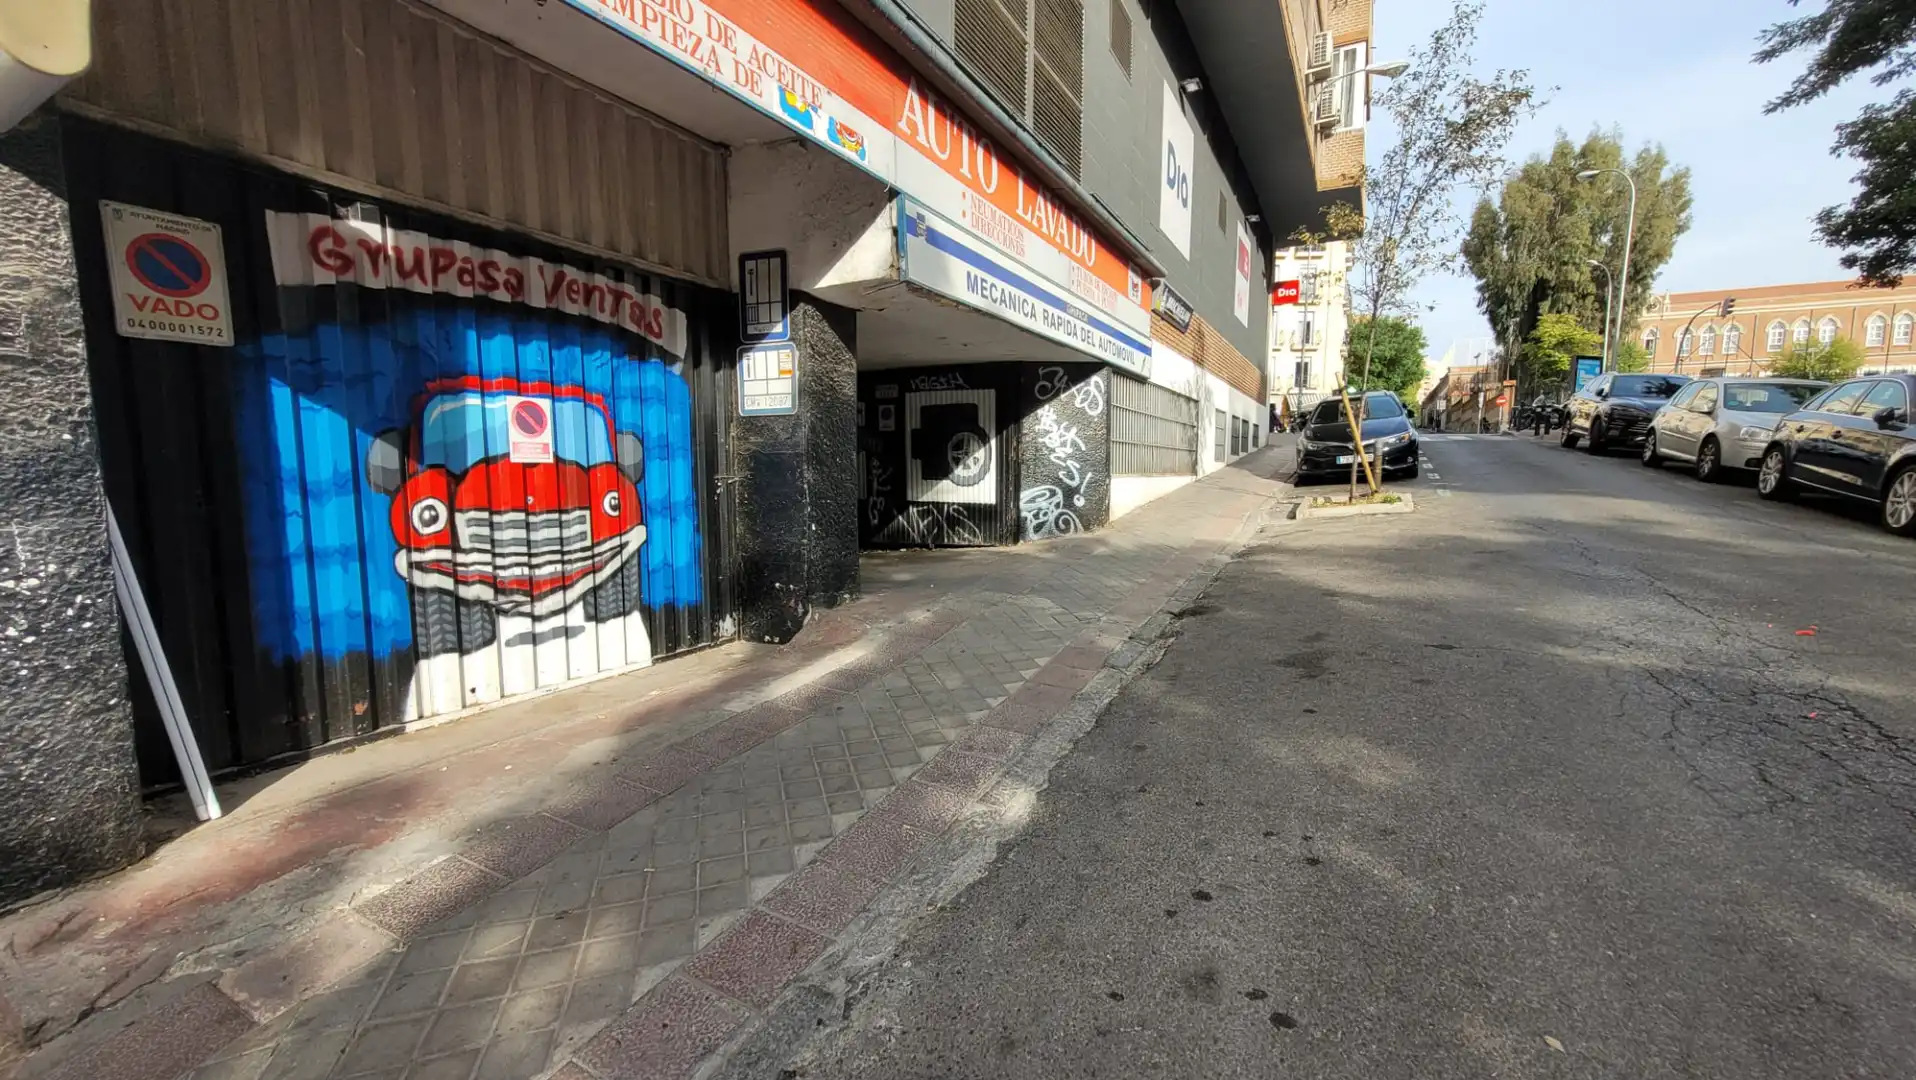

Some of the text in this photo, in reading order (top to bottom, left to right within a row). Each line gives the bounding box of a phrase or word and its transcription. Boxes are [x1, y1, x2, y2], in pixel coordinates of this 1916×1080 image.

[704, 10, 737, 54] DE
[747, 44, 822, 109] ACEITE
[732, 57, 763, 98] DE
[897, 77, 1096, 267] AUTO LAVADO
[126, 292, 219, 320] VADO
[127, 318, 224, 337] 0400001572
[966, 270, 1037, 322] MECANICA
[1042, 307, 1078, 341] RAPIDA
[1080, 327, 1096, 348] DEL
[1098, 335, 1136, 365] AUTOMOVIL
